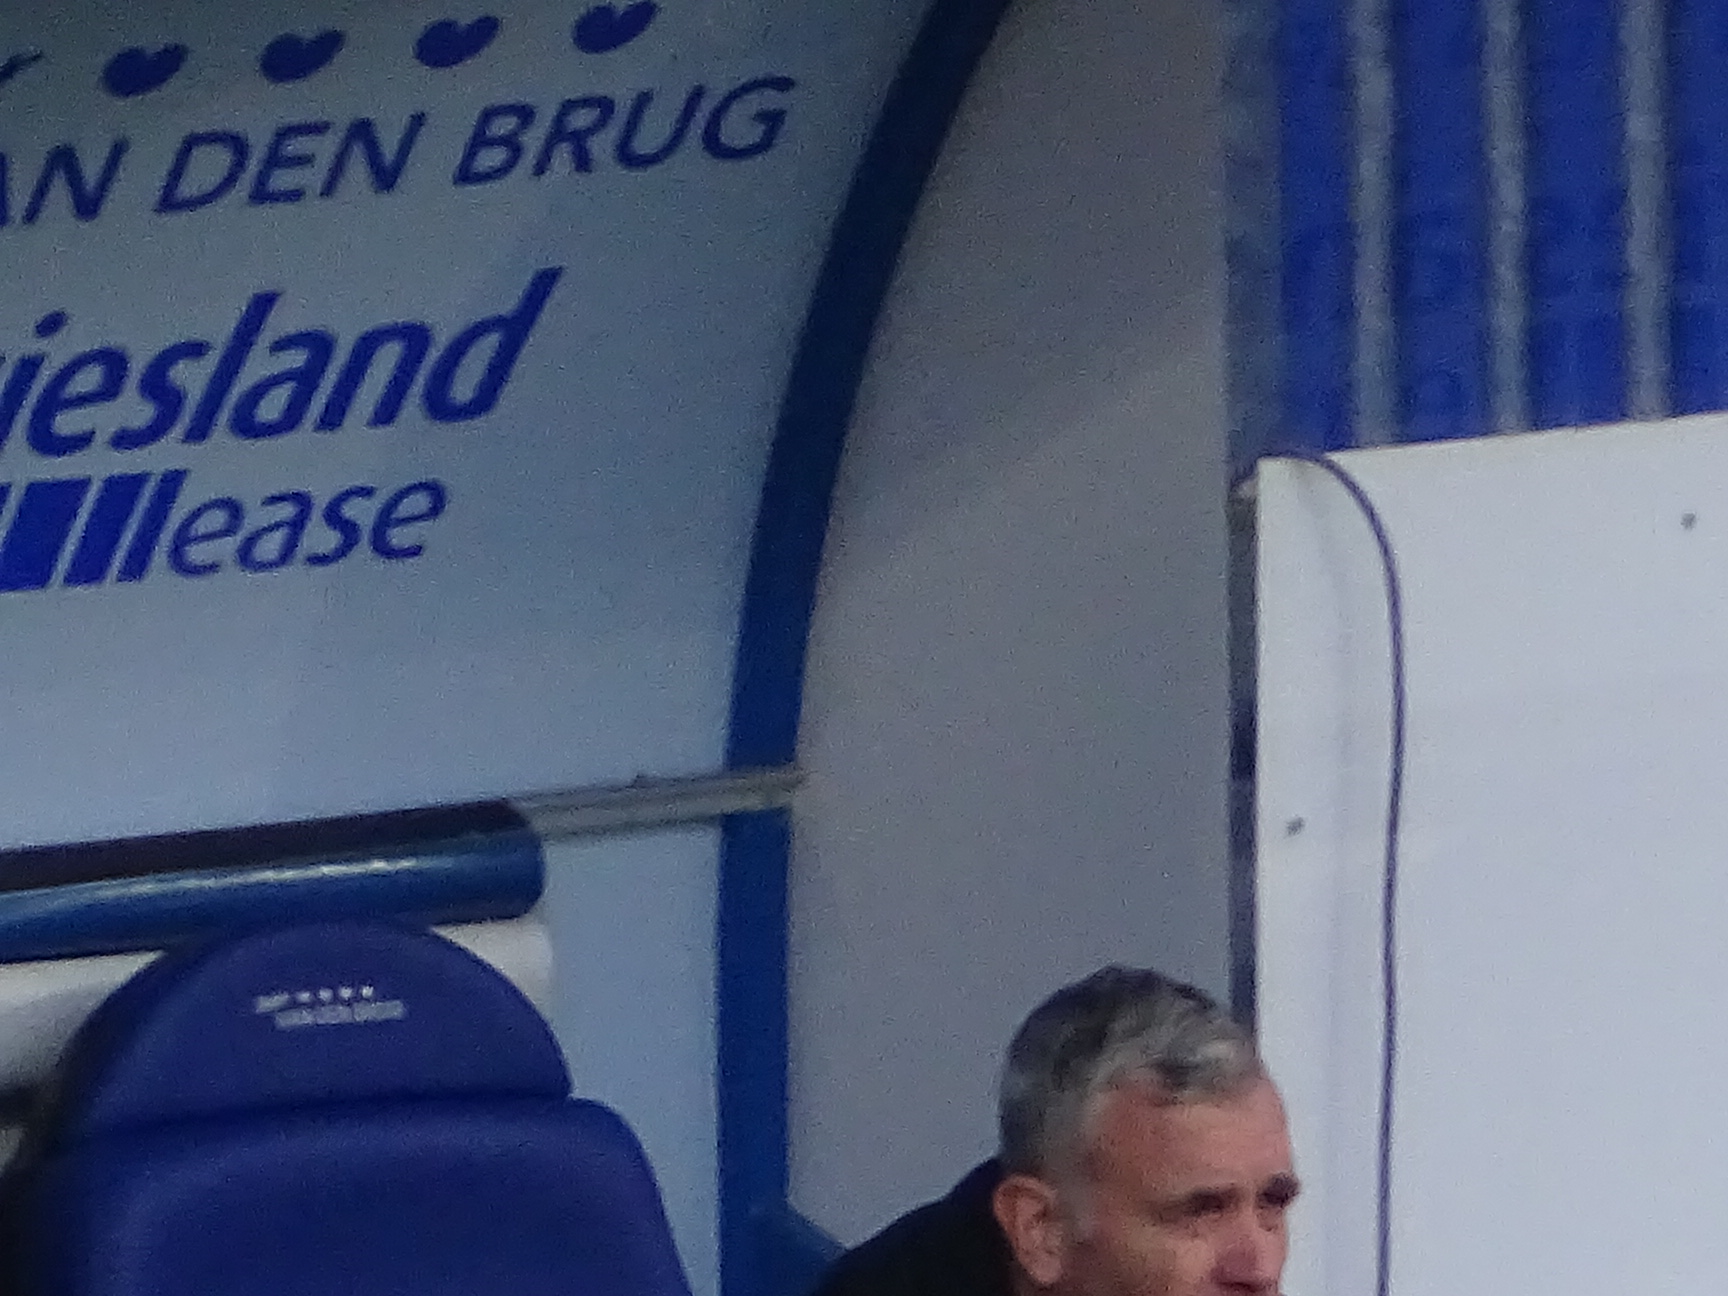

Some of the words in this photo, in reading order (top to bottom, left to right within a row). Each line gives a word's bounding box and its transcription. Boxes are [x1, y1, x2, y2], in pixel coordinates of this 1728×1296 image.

[0, 136, 130, 227] N
[153, 110, 427, 215] DEN
[452, 75, 796, 188] BRUG
[0, 265, 565, 458] iesland
